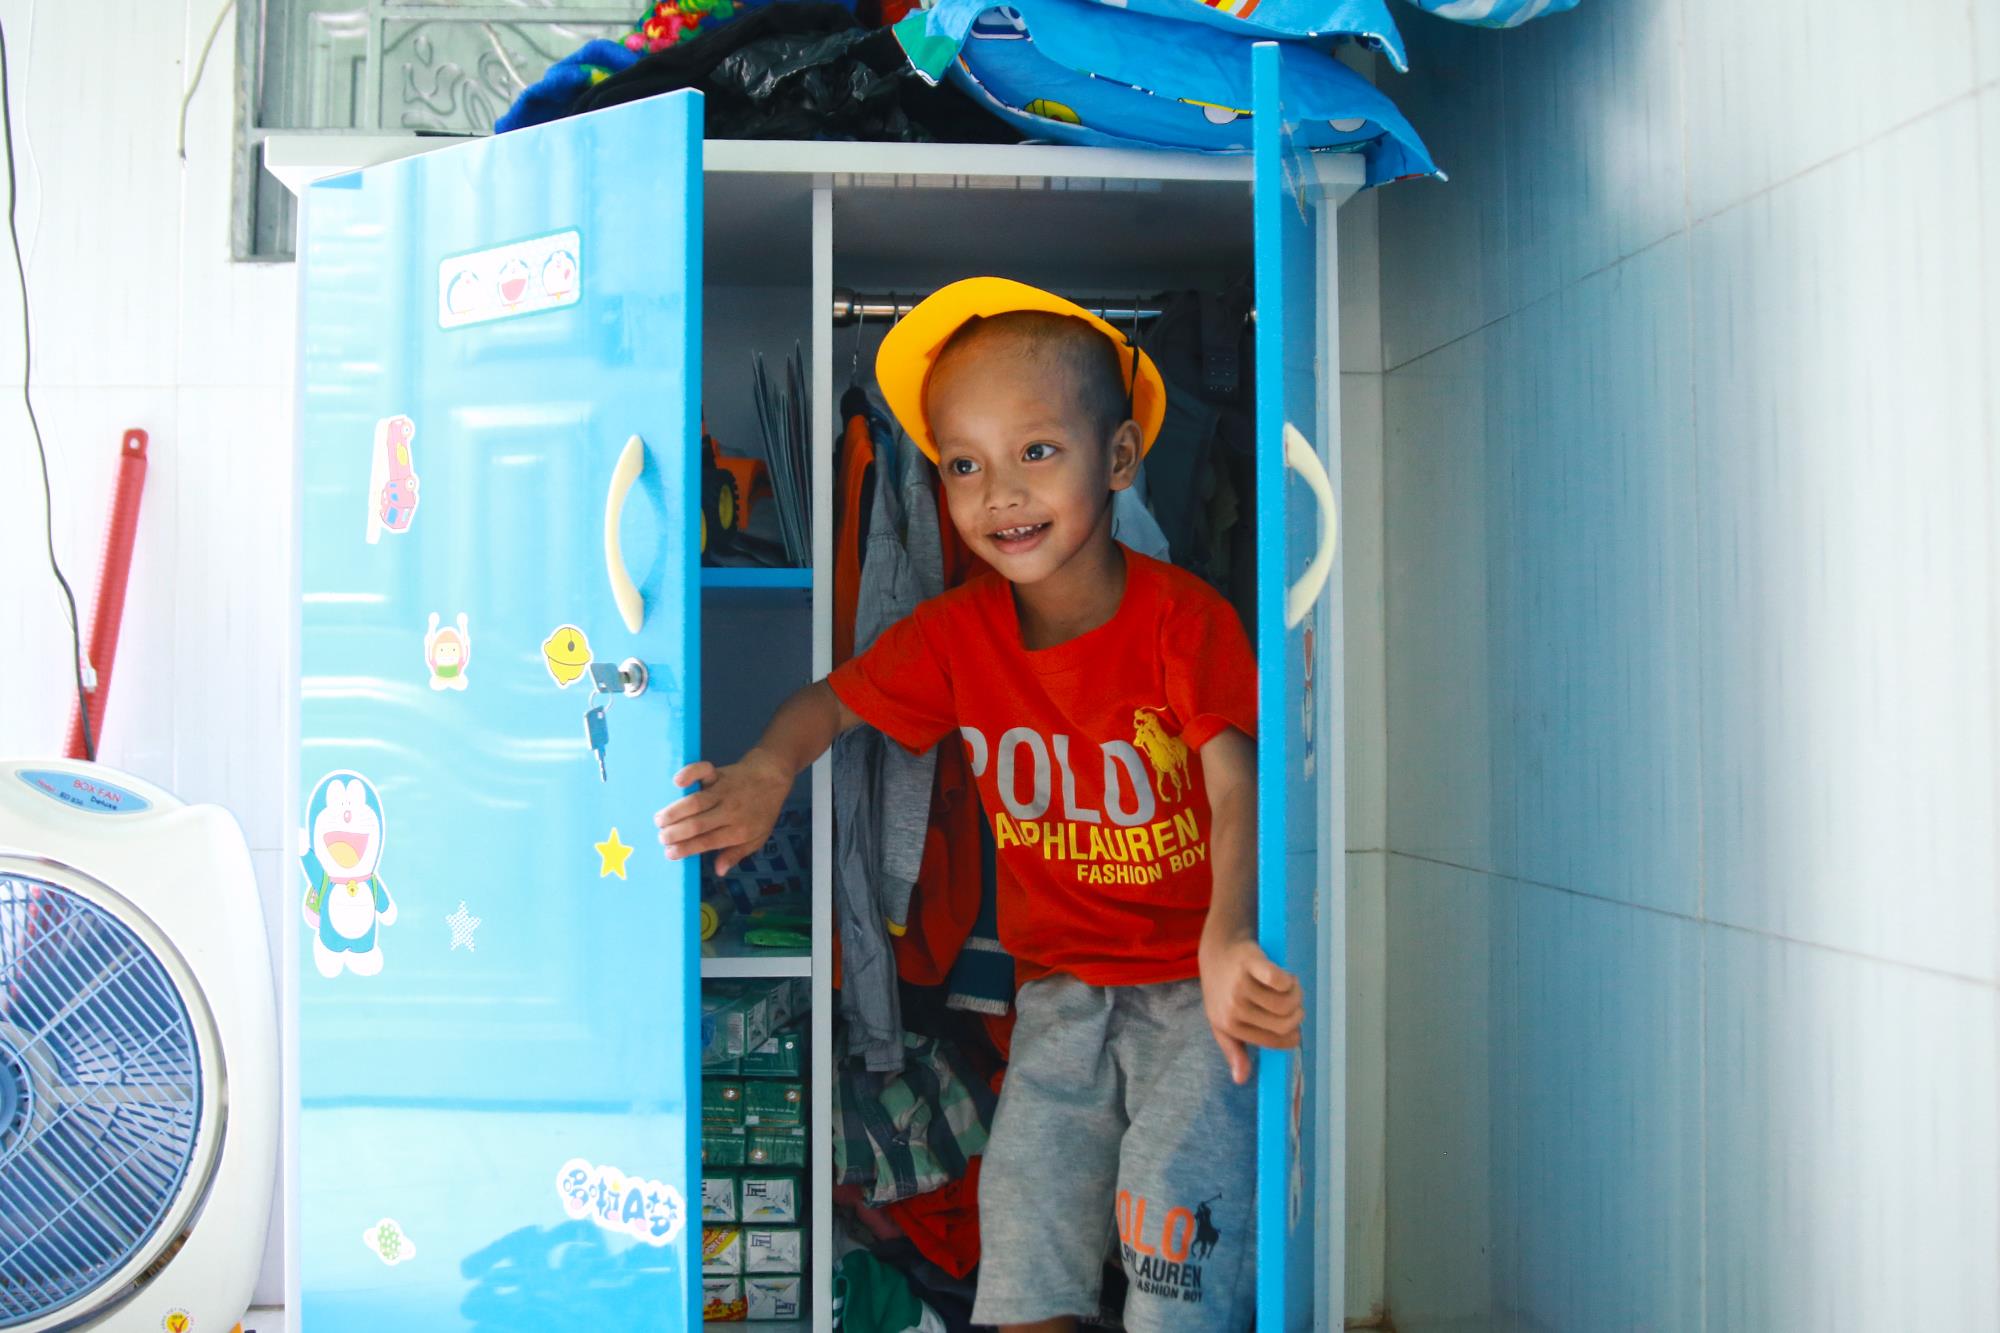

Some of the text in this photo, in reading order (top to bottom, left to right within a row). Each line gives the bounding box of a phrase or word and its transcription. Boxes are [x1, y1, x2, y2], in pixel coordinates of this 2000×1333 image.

[73, 779, 95, 793] BOX
[1077, 842, 1207, 886] FASHION BOY
[1136, 1277, 1180, 1299] ASHION
